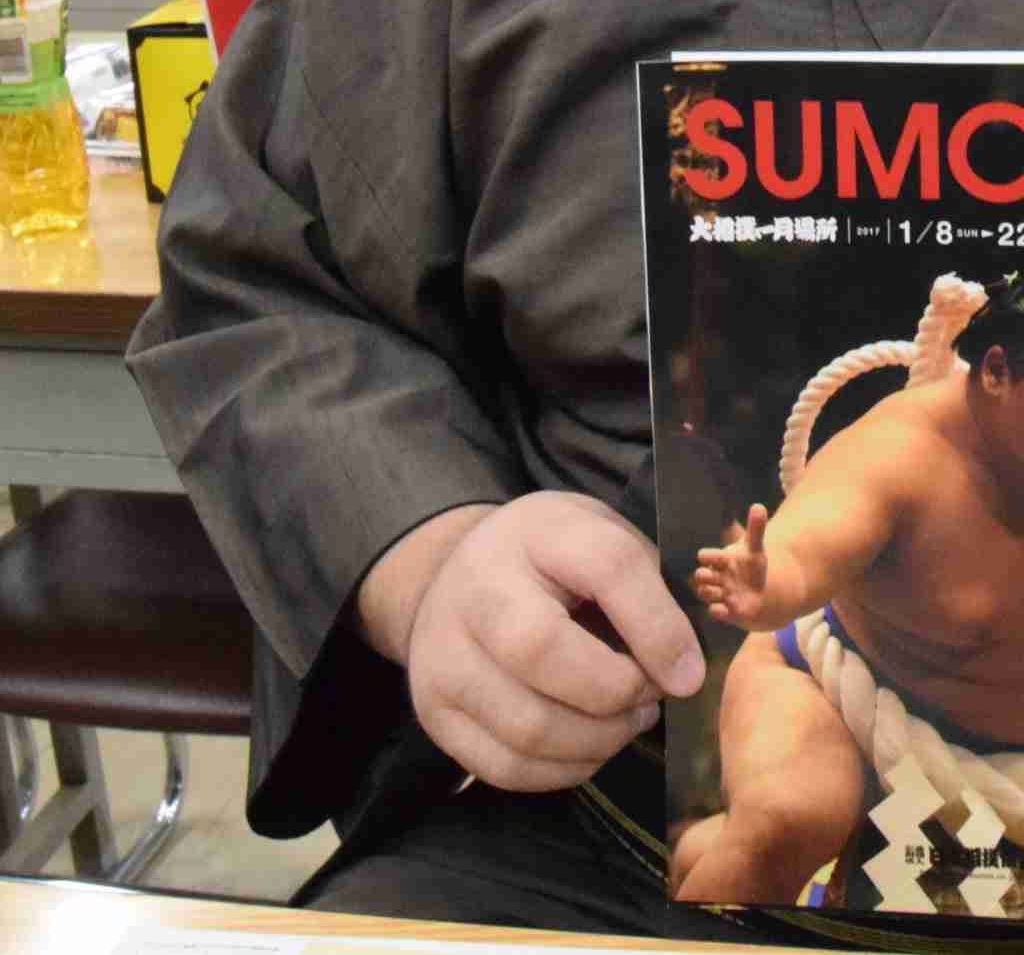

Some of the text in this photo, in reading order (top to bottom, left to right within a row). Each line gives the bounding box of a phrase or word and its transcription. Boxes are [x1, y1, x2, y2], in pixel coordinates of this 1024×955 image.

[857, 226, 880, 236] 2017
[899, 219, 952, 245] 1/8
[957, 228, 978, 238] SUN
